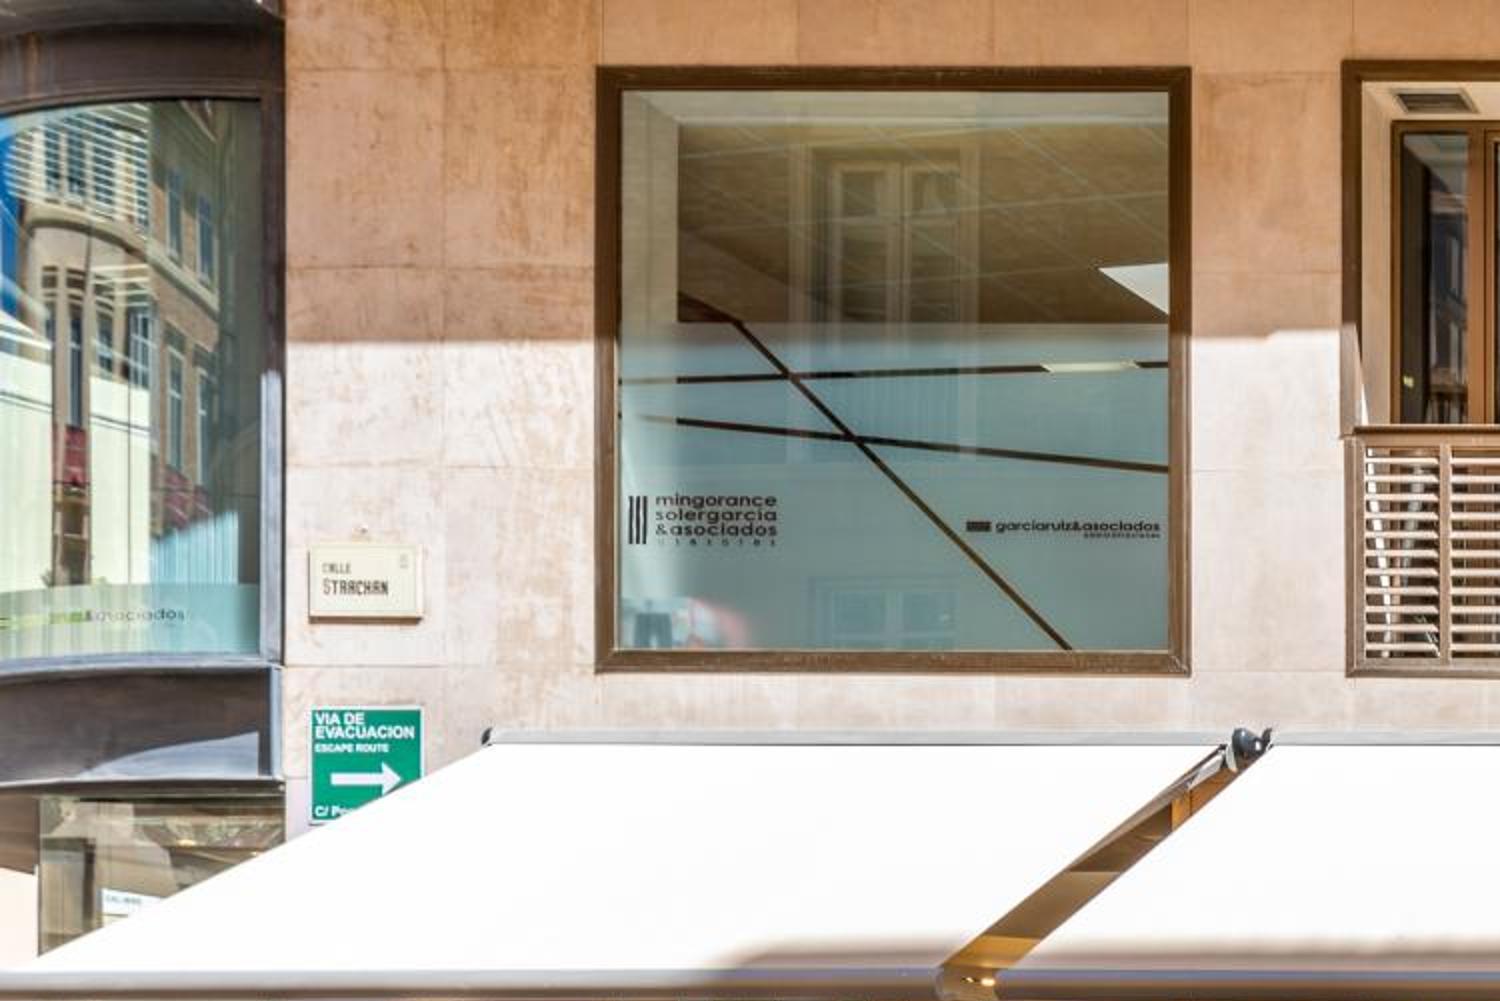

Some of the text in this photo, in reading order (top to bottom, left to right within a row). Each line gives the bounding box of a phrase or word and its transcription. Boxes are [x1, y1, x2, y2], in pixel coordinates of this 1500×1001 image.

[655, 492, 777, 509] mingorance
[321, 563, 352, 575] CALLE
[323, 578, 389, 596] STRACHAN
[315, 712, 365, 725] VIA DE
[315, 725, 416, 739] EVACUACION
[315, 743, 389, 753] ESCAPE ROUTE
[315, 805, 329, 817] C/
